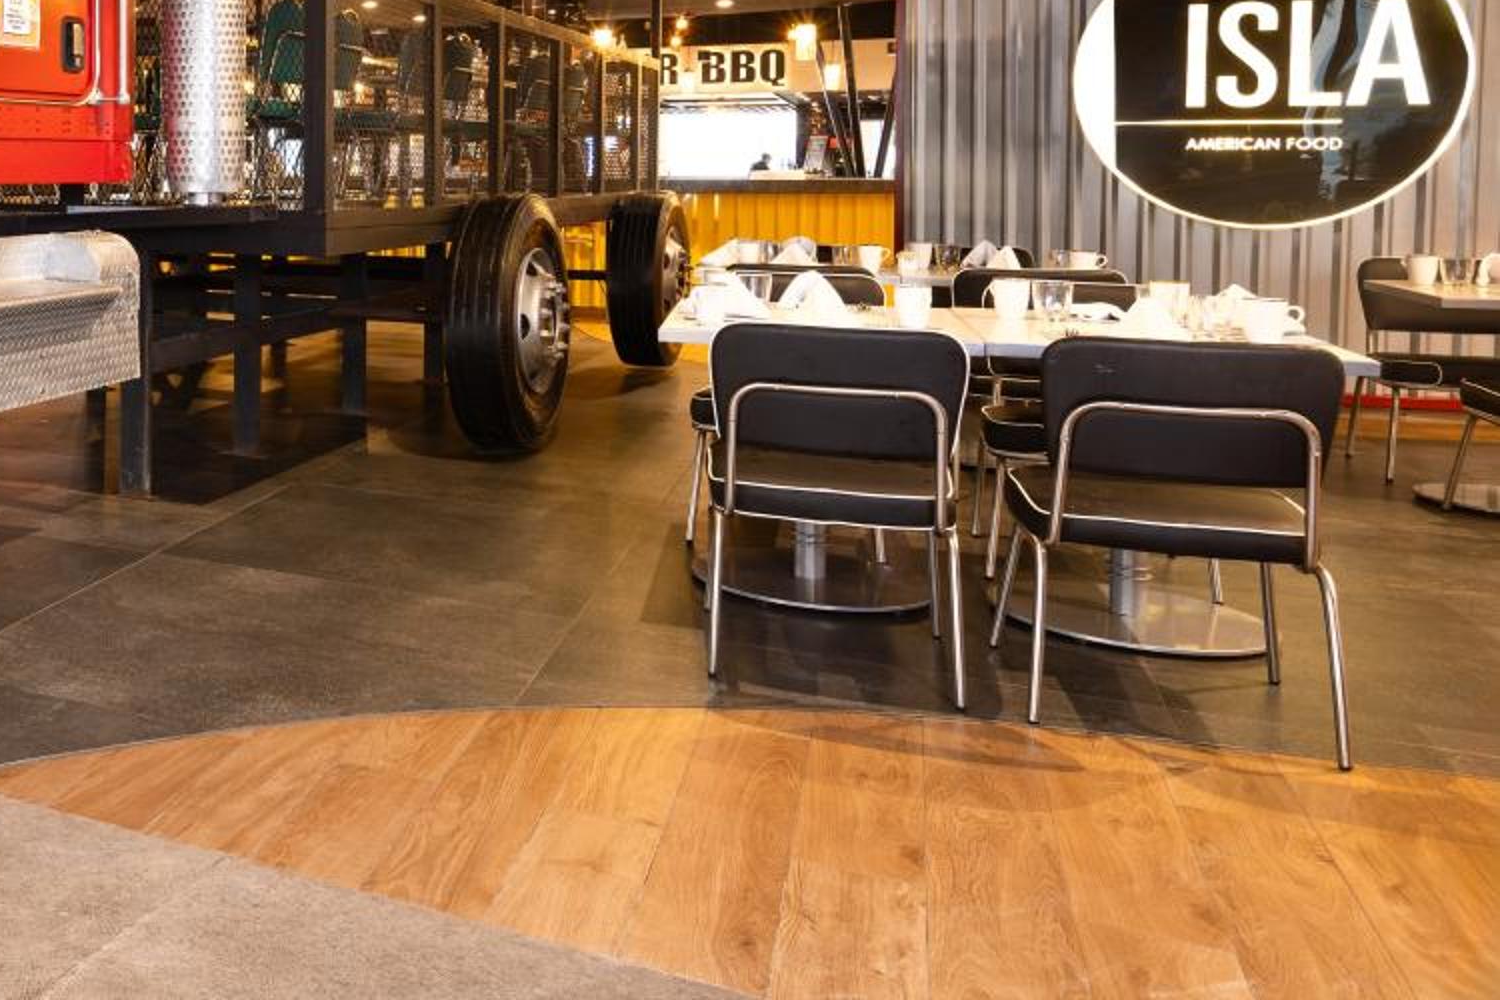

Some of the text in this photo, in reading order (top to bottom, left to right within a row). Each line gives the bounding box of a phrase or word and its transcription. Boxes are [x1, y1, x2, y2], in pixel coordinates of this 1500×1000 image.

[701, 49, 786, 87] BBQ
[1185, 136, 1344, 151] AMERICAN FOOD
